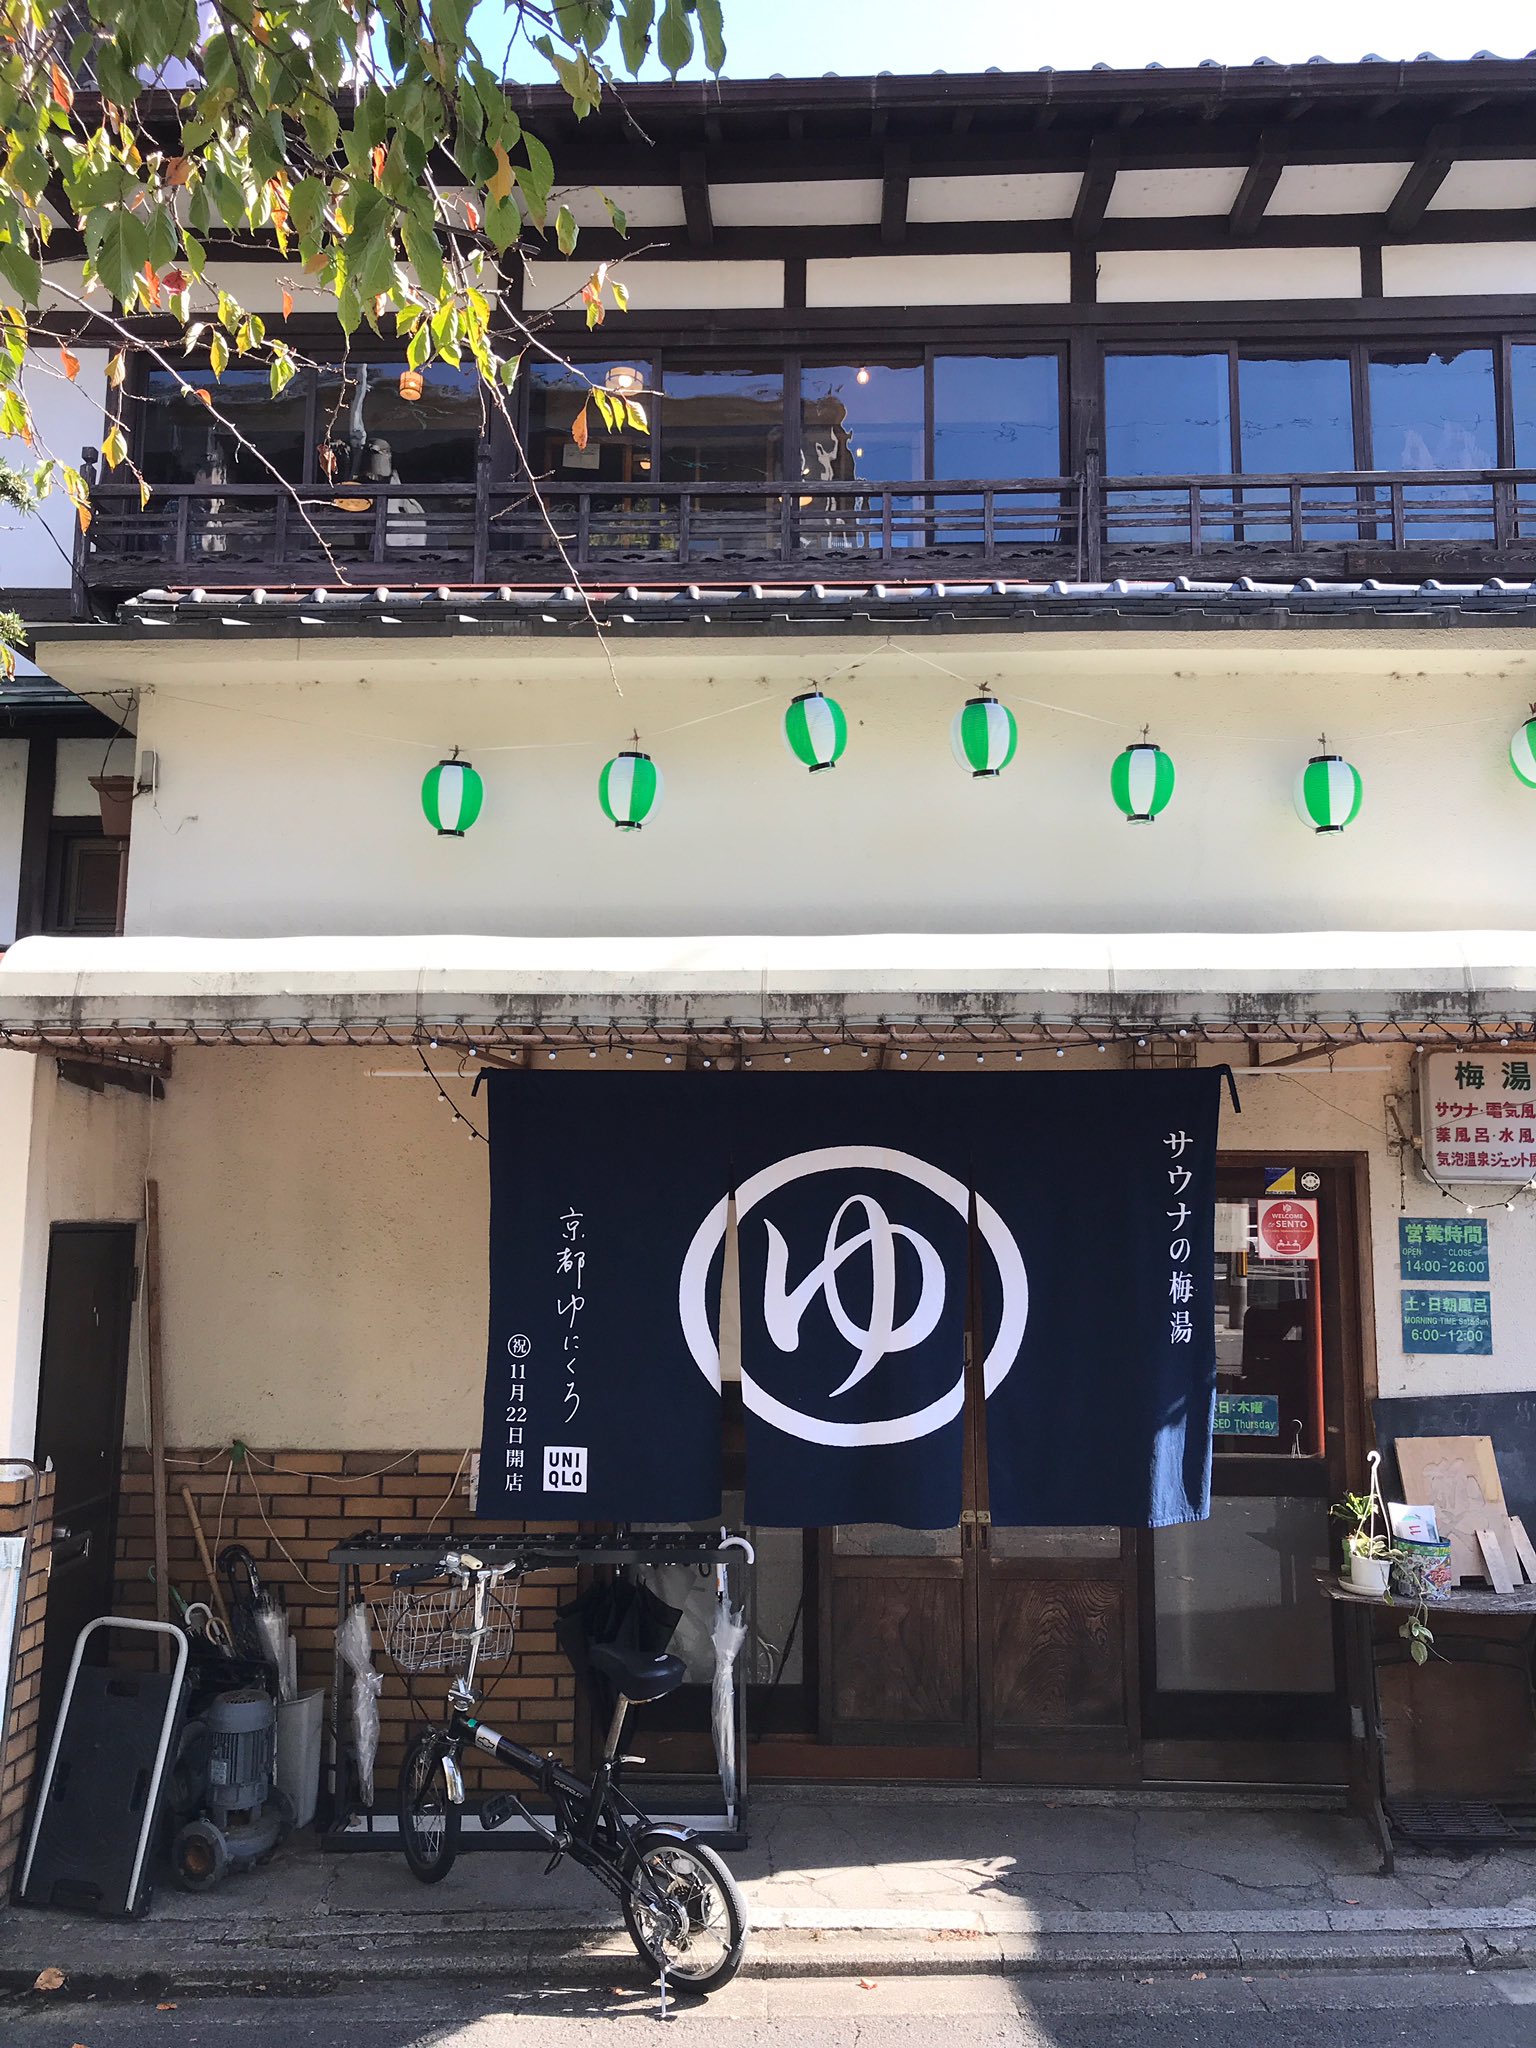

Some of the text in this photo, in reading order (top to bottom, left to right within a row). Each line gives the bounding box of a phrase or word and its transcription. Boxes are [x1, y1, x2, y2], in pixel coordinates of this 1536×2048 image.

[1455, 1061, 1531, 1091] 梅湯
[1276, 1220, 1308, 1228] SENTO
[1163, 1130, 1194, 1344] サウナの梅湯
[1405, 1223, 1482, 1244] 営業時間
[1402, 1247, 1472, 1257] OPEN CLOSE
[1406, 1260, 1485, 1273] 14:00-26:00
[763, 1194, 946, 1398] ゆ
[556, 1206, 586, 1423] 京都ゆにくろ
[1404, 1316, 1438, 1325] MORNING
[1440, 1317, 1457, 1325] TIME
[1411, 1328, 1483, 1342] 6:00-12:00
[1234, 1419, 1277, 1430] Thursday
[549, 1452, 580, 1467] UNI
[548, 1471, 583, 1488] QLO
